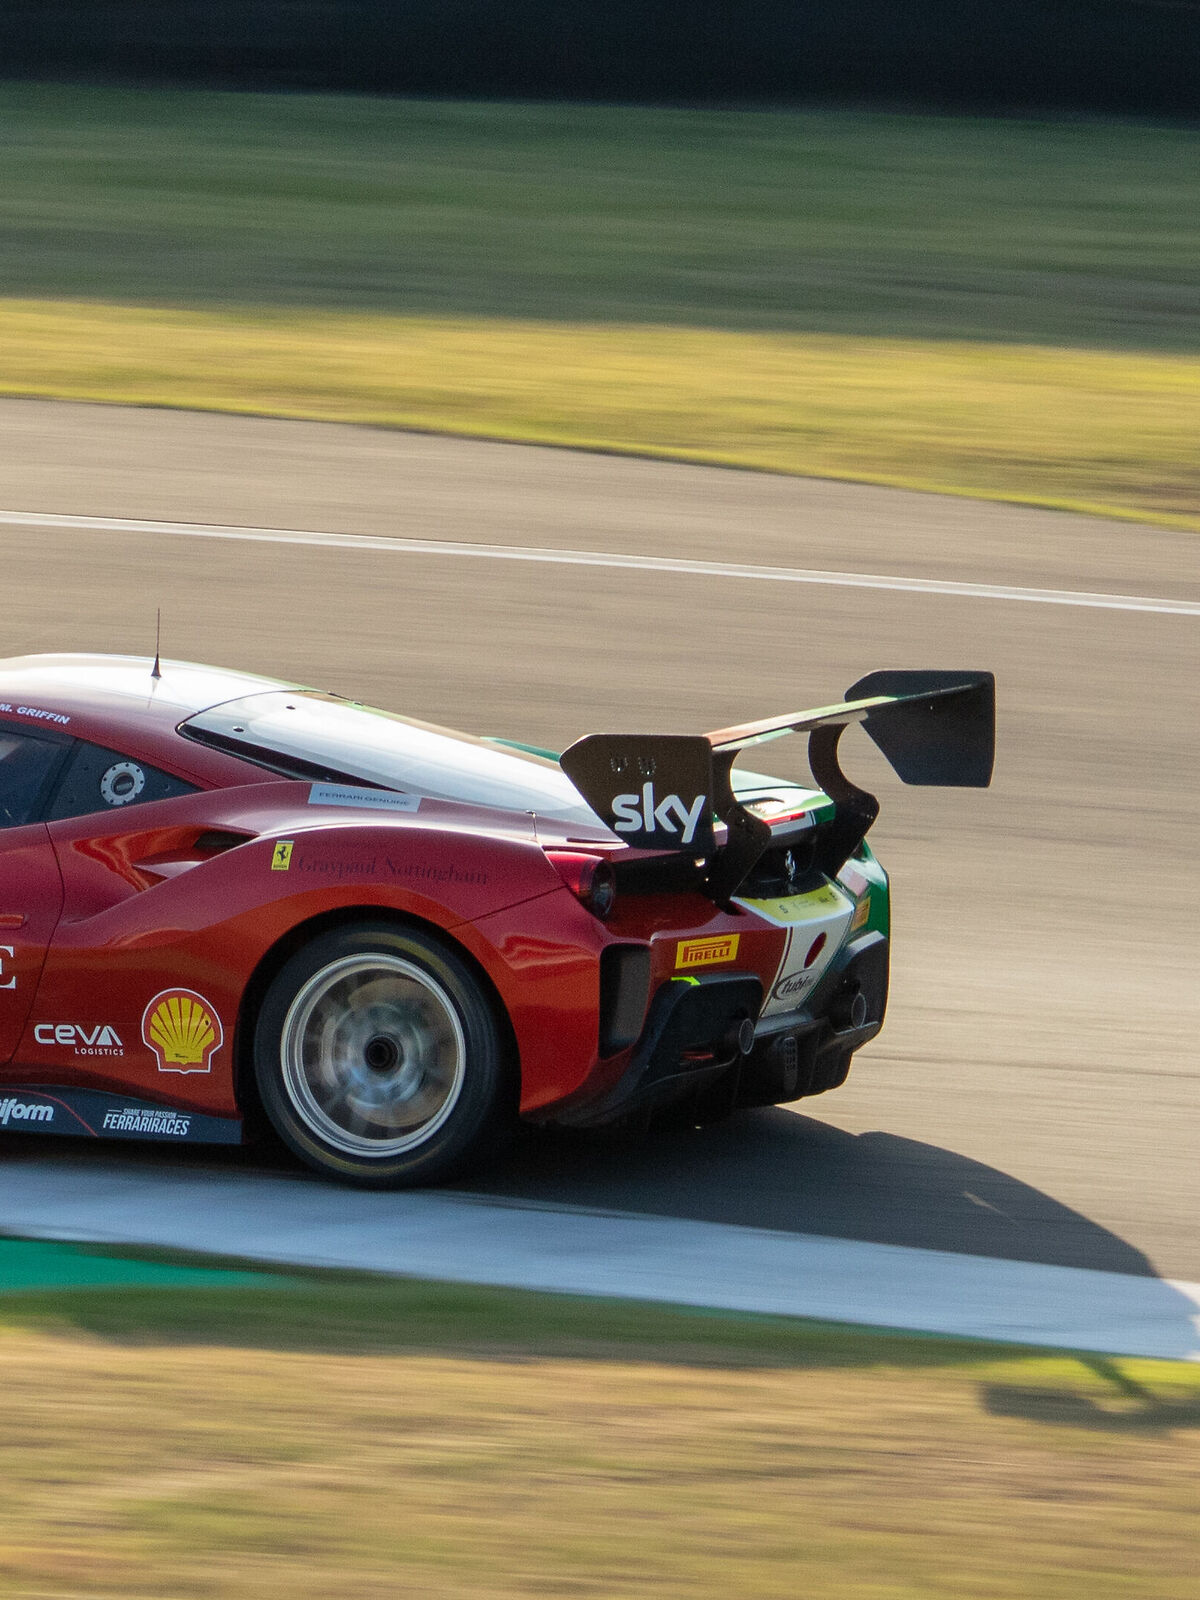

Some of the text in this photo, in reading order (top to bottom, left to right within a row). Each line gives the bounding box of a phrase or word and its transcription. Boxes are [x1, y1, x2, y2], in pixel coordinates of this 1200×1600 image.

[16, 706, 71, 725] GRIFFIN
[319, 791, 363, 801] FERRARI
[611, 782, 706, 843] sky
[682, 941, 732, 963] PIRELLI
[74, 1048, 124, 1056] LOGISTICS
[103, 1113, 190, 1135] FERRARIRACES
